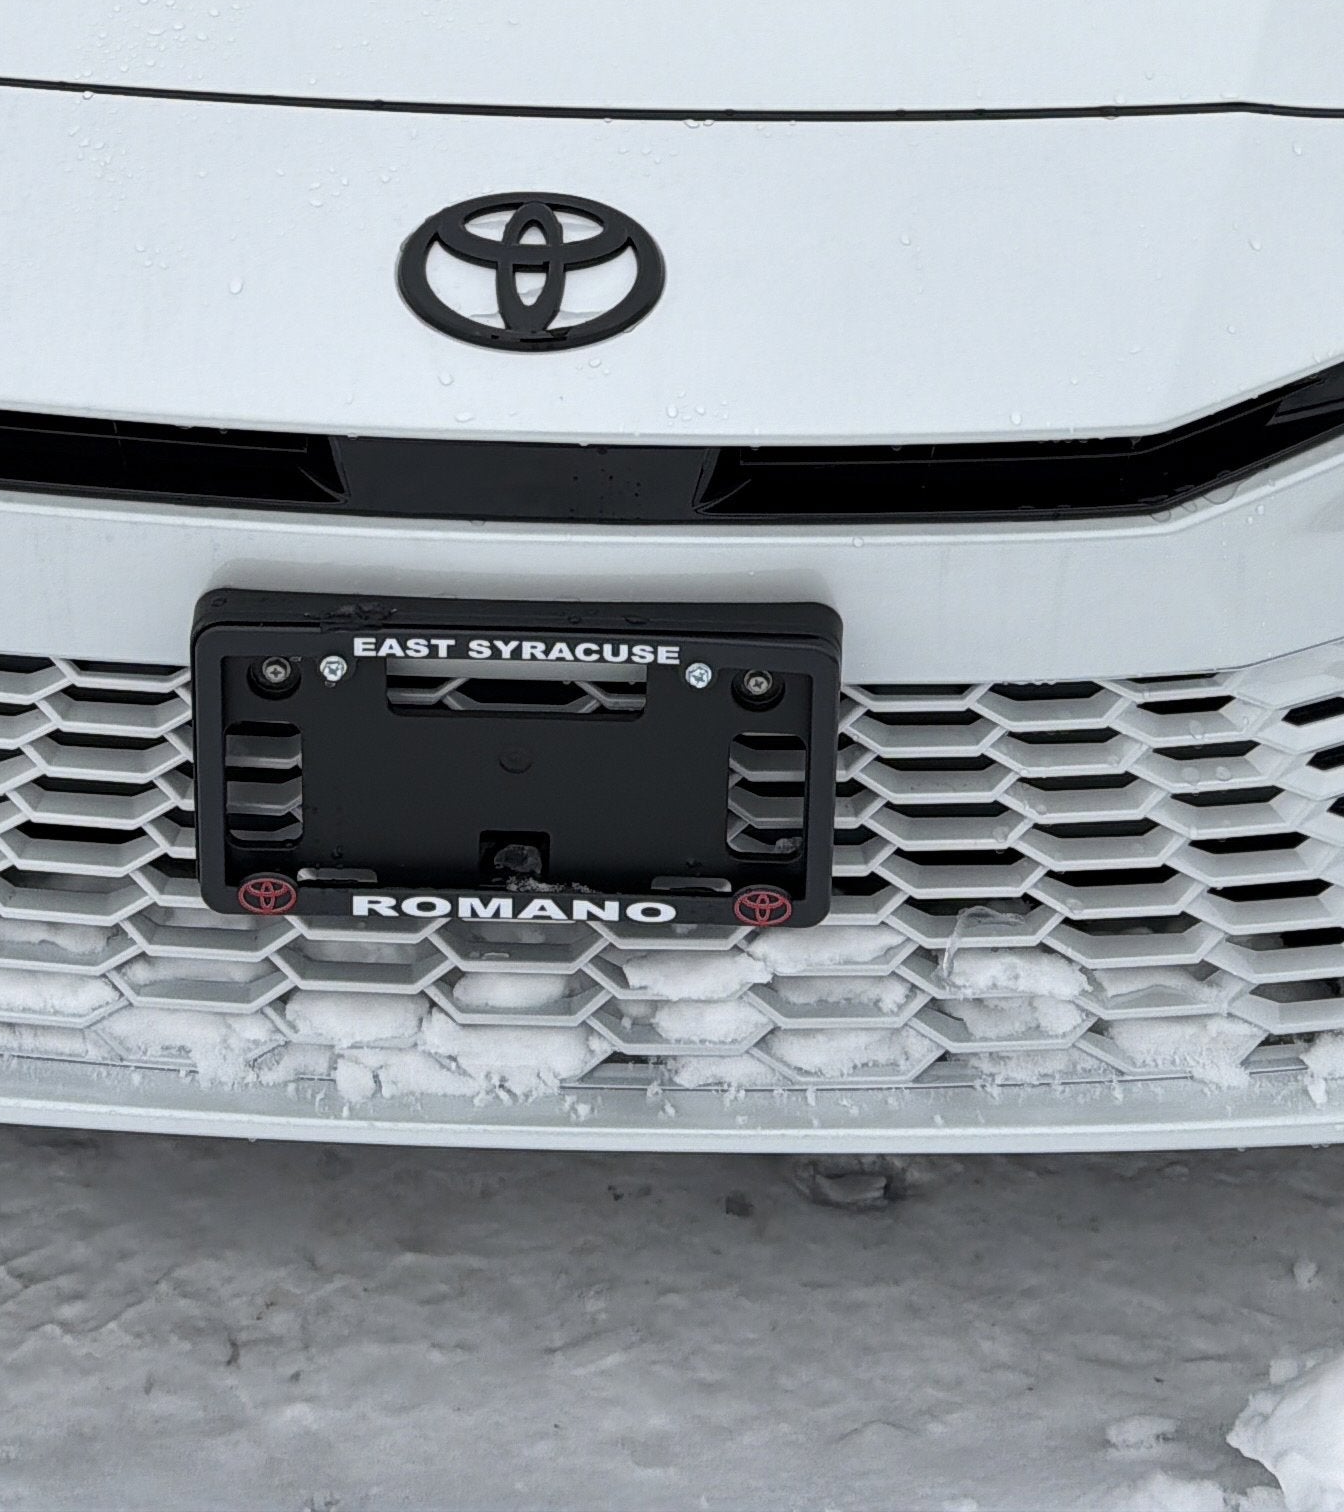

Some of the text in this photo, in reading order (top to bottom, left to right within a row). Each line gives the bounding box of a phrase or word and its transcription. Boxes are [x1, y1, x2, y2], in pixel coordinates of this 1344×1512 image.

[353, 637, 681, 665] EAST SYRACUSE
[352, 895, 677, 923] ROMANO
